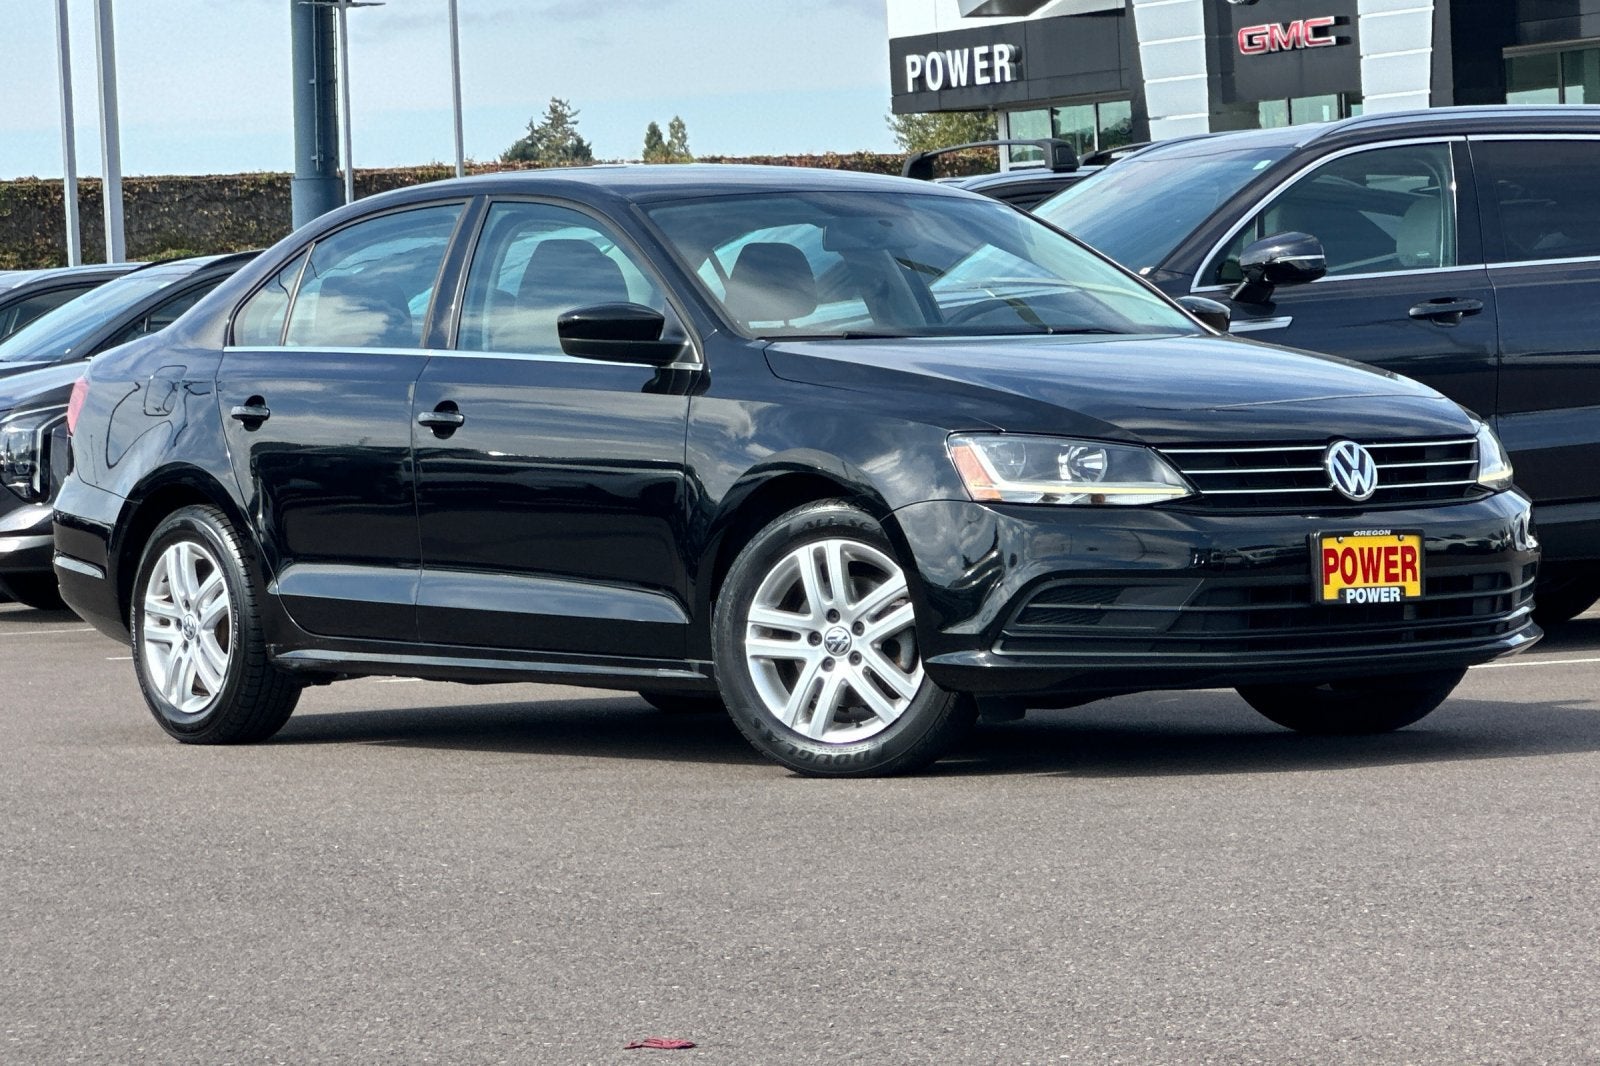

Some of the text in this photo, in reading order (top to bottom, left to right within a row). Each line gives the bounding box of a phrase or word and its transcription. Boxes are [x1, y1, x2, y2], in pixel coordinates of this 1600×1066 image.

[1238, 16, 1336, 54] GMC
[905, 43, 1013, 93] POWER
[1353, 529, 1392, 537] OREGON
[1323, 545, 1418, 585] POWER
[1345, 586, 1401, 604] POWER
